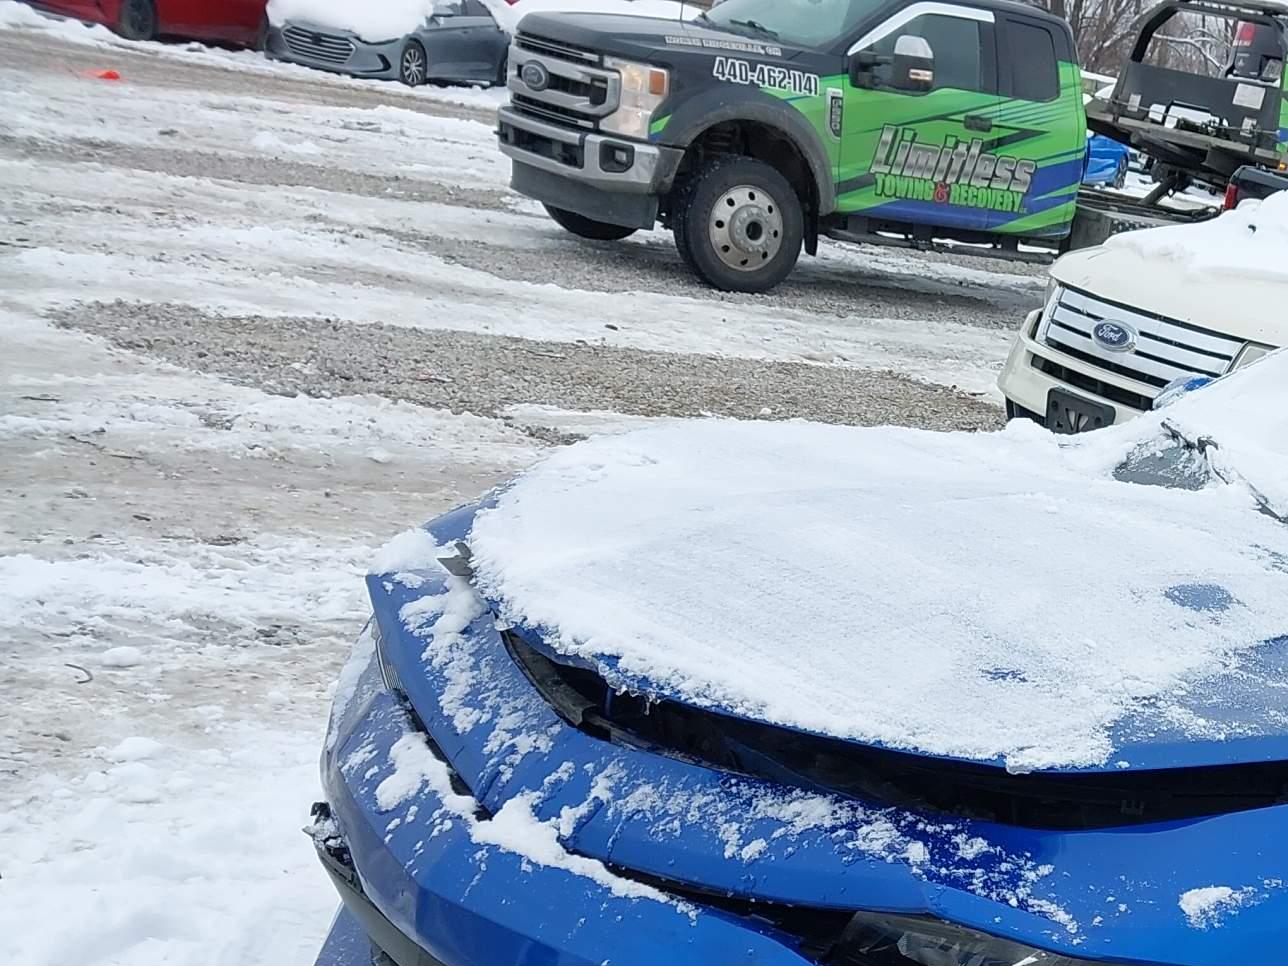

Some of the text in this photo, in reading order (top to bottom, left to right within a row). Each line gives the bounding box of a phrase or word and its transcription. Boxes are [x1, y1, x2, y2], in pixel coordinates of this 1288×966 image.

[713, 56, 820, 97] 440-462-1141
[870, 123, 1038, 193] Limitless
[874, 172, 1024, 213] TOWING & RECOVERY
[1098, 324, 1122, 342] Ford
